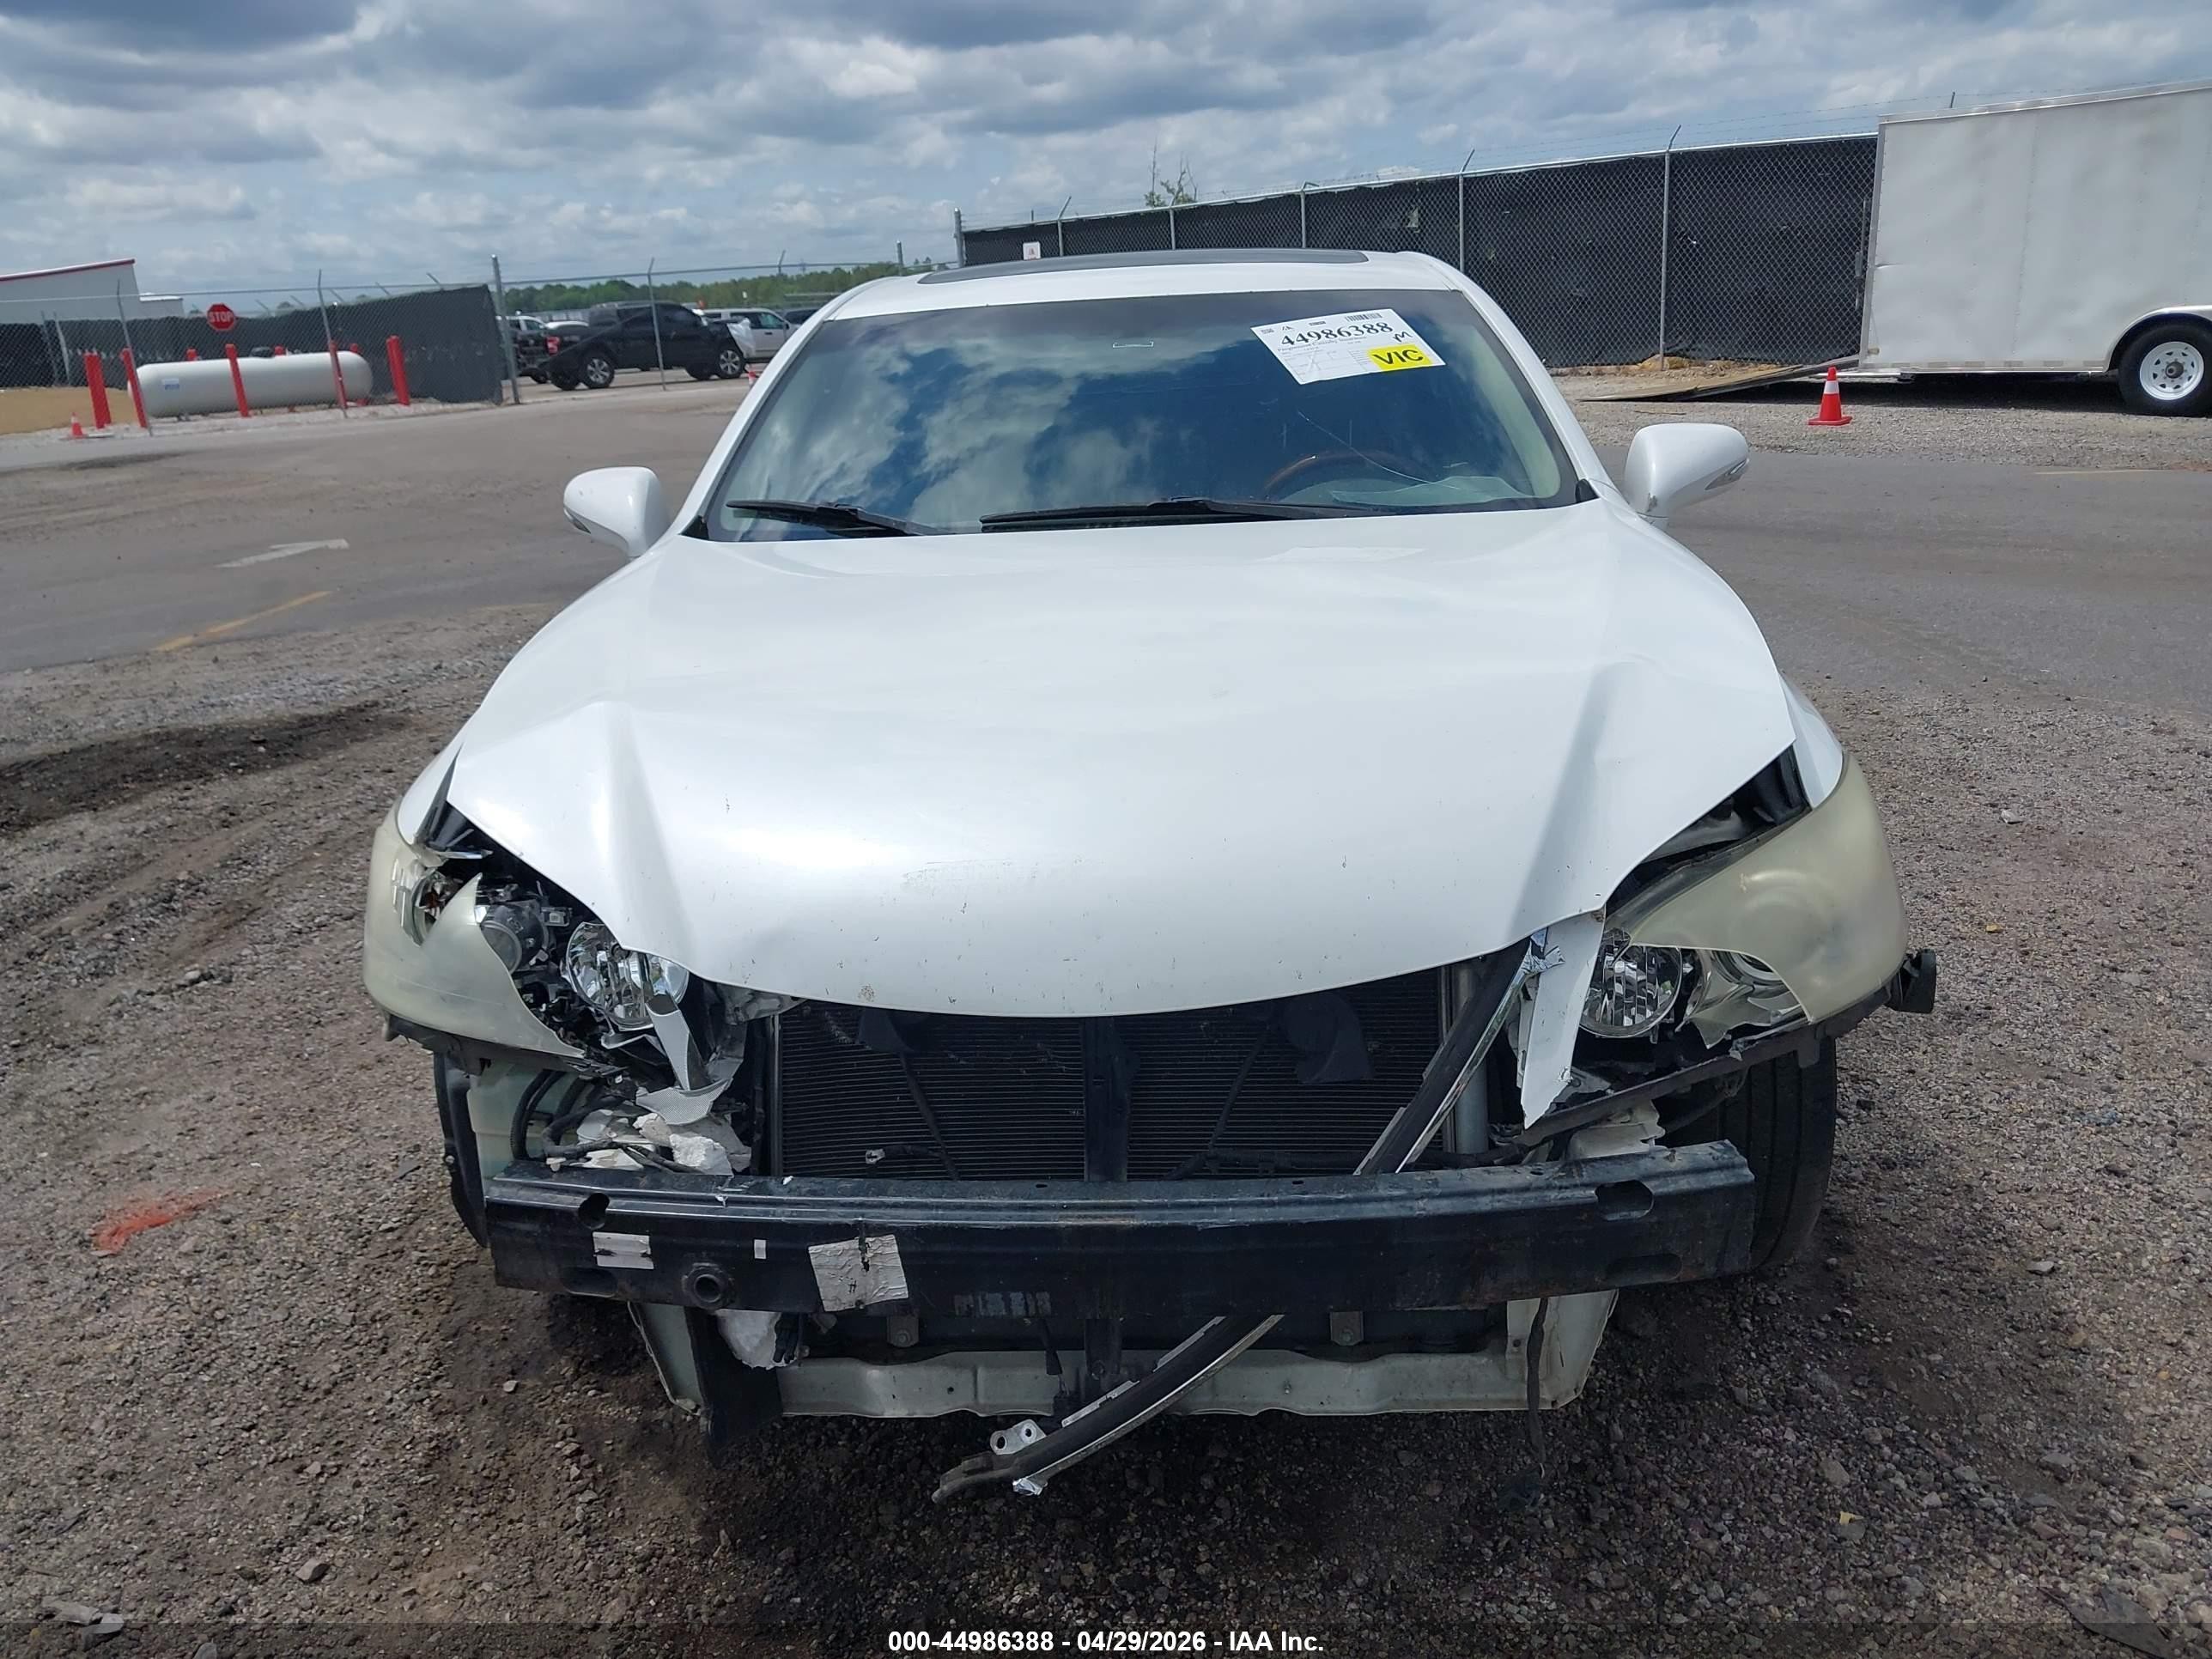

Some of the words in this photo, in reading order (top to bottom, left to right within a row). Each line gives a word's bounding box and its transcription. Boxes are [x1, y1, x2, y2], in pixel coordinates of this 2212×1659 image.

[209, 311, 233, 322] STOP
[1281, 321, 1394, 345] 44986388
[1372, 349, 1424, 365] VIC
